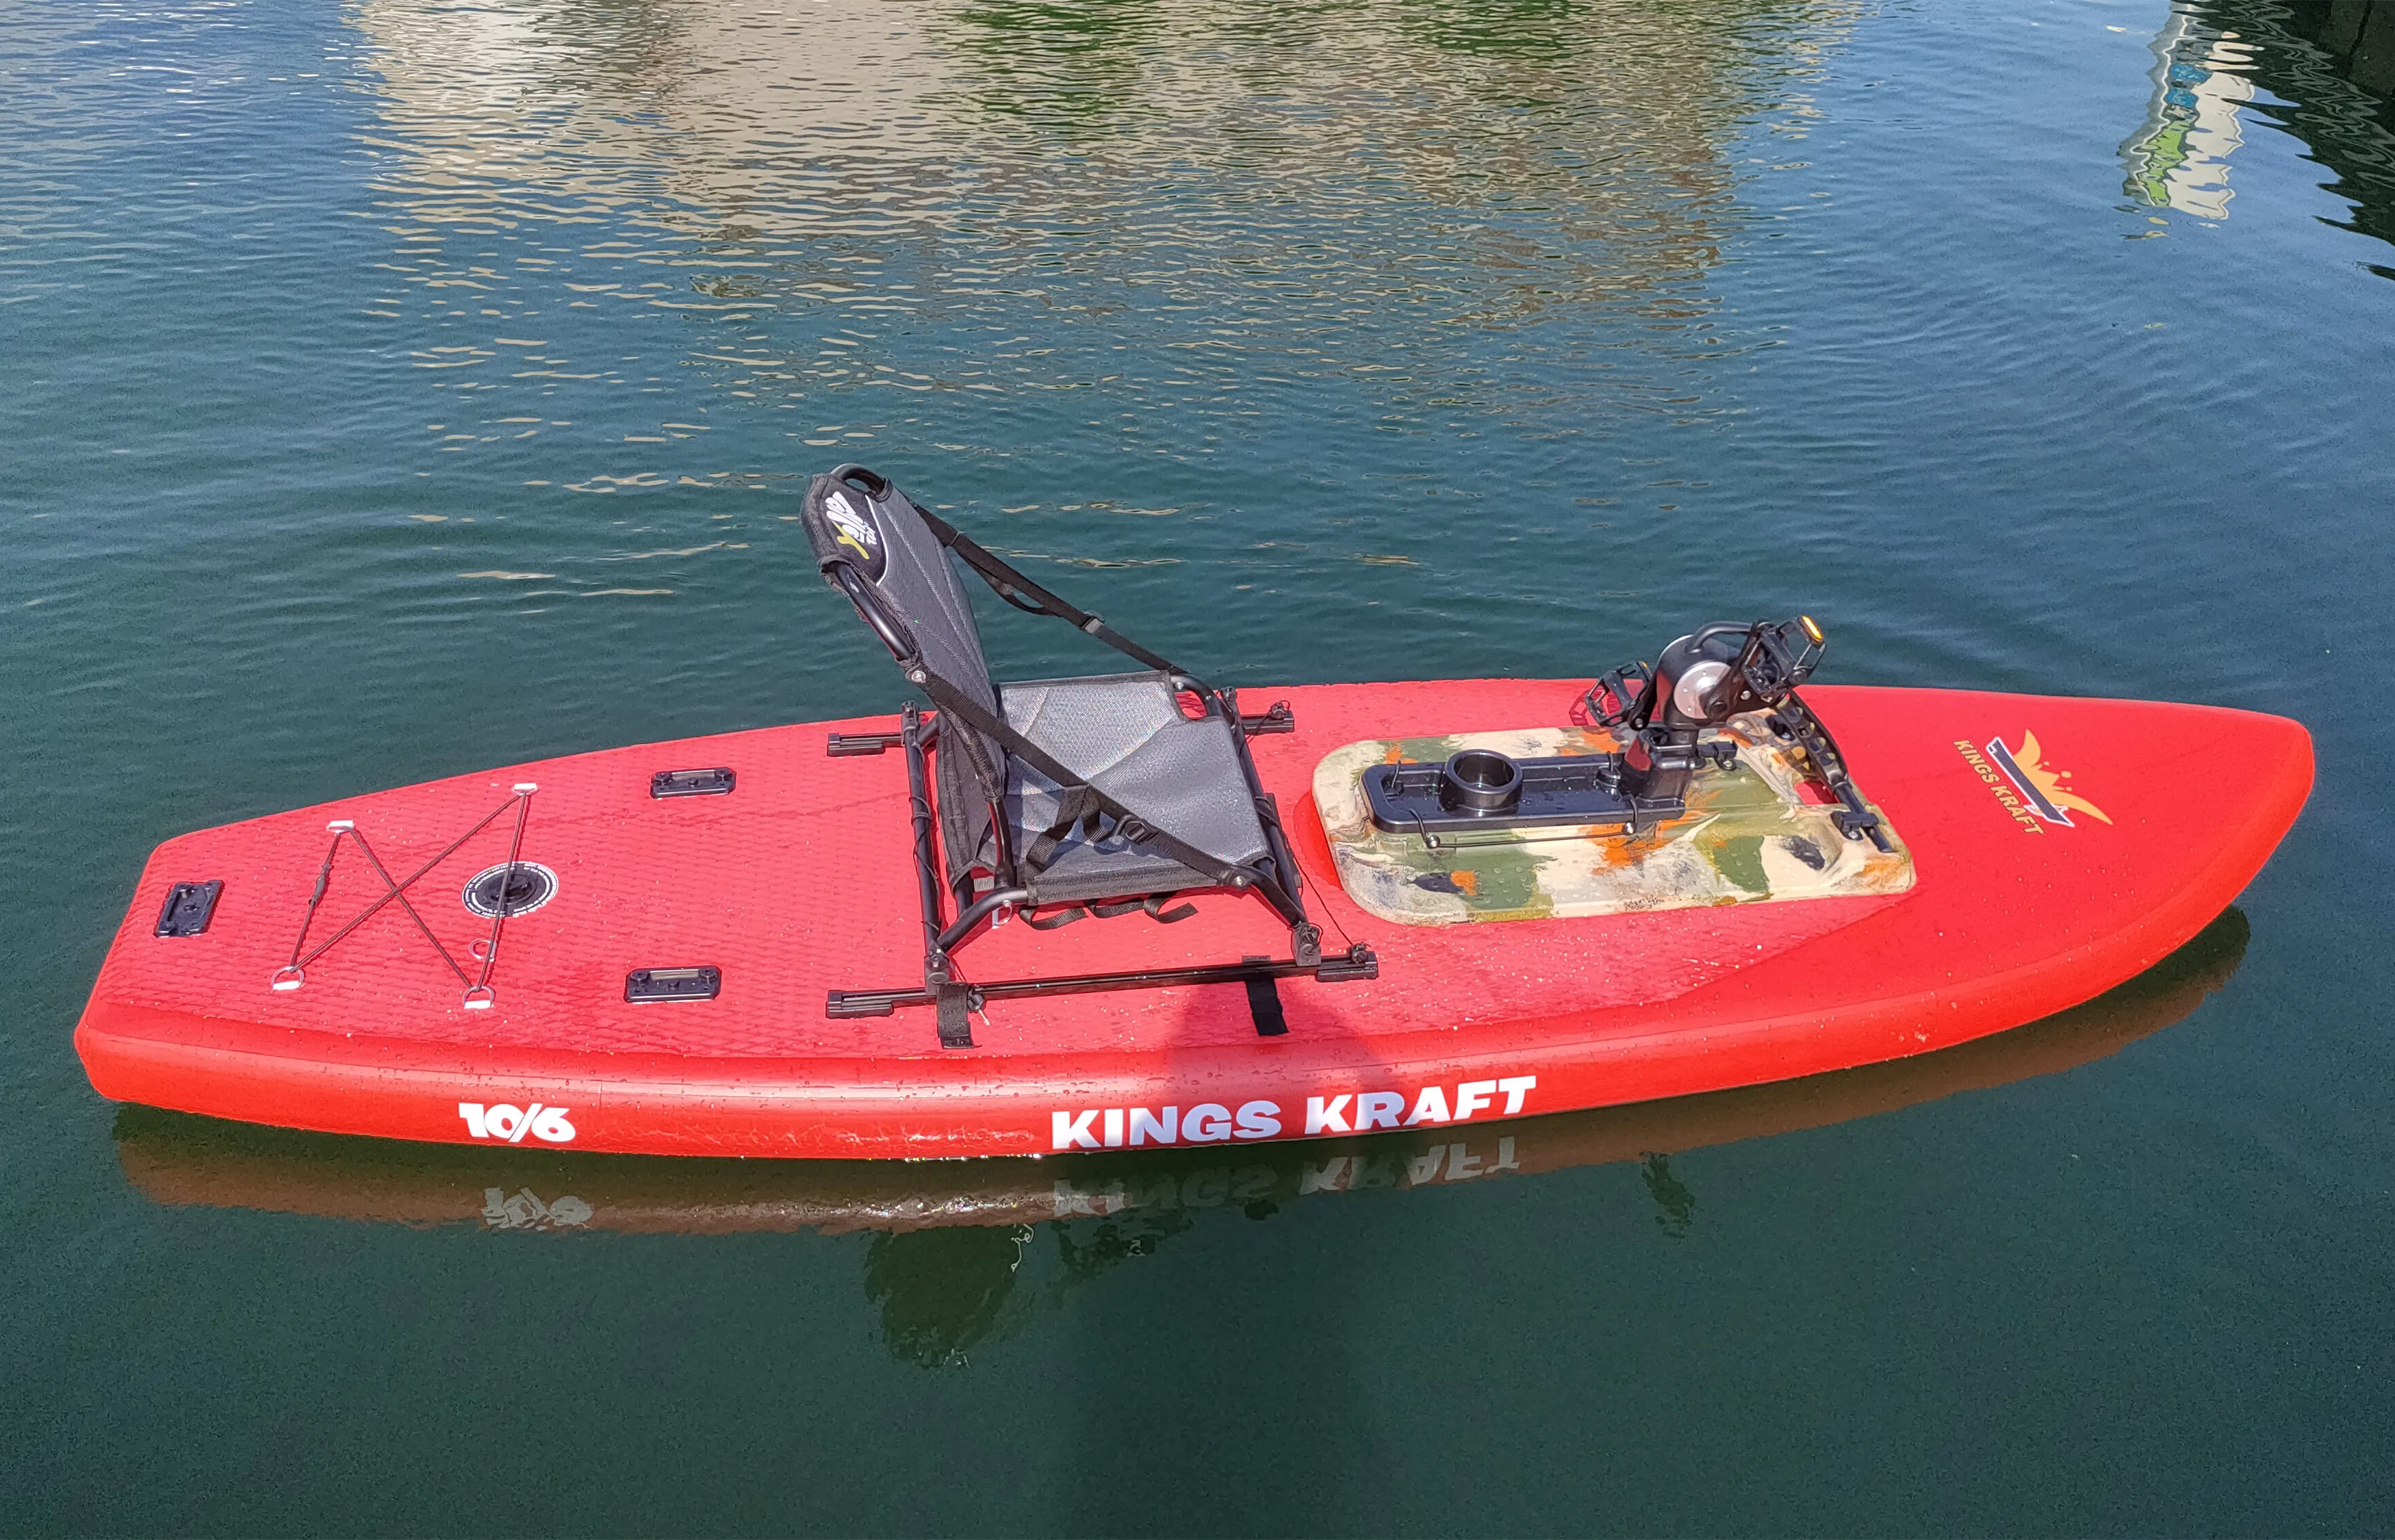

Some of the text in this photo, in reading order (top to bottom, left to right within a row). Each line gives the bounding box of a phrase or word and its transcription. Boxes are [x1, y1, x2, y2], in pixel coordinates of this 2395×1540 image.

[1952, 739, 2047, 835] KINGS KRAFT
[458, 1103, 576, 1142] 10/6
[1051, 1075, 1537, 1150] KINGS KRAFT
